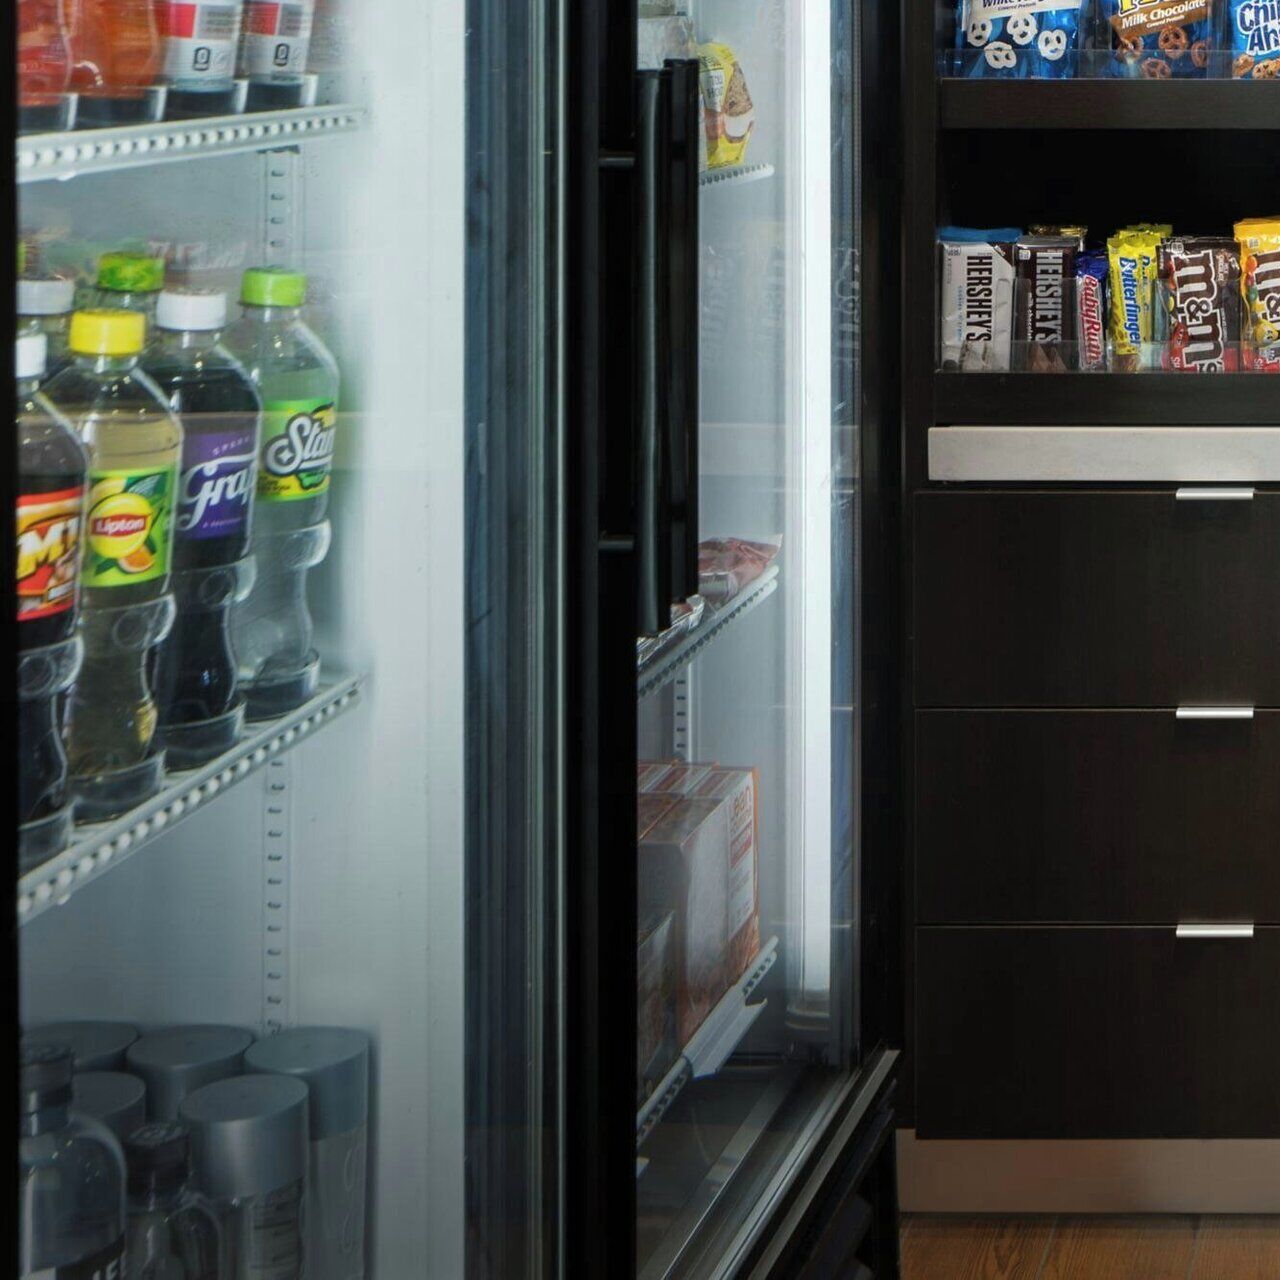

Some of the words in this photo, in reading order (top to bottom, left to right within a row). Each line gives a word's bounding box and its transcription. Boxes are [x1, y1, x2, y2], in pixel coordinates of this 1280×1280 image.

[1121, 14, 1149, 30] Milk
[966, 255, 993, 342] HERSHEY'S
[1035, 251, 1063, 344] HERSHEY'S
[1081, 274, 1100, 320] Baby
[1119, 256, 1142, 348] Butterfinger
[1083, 317, 1104, 364] Ruth
[96, 516, 146, 536] Lipton
